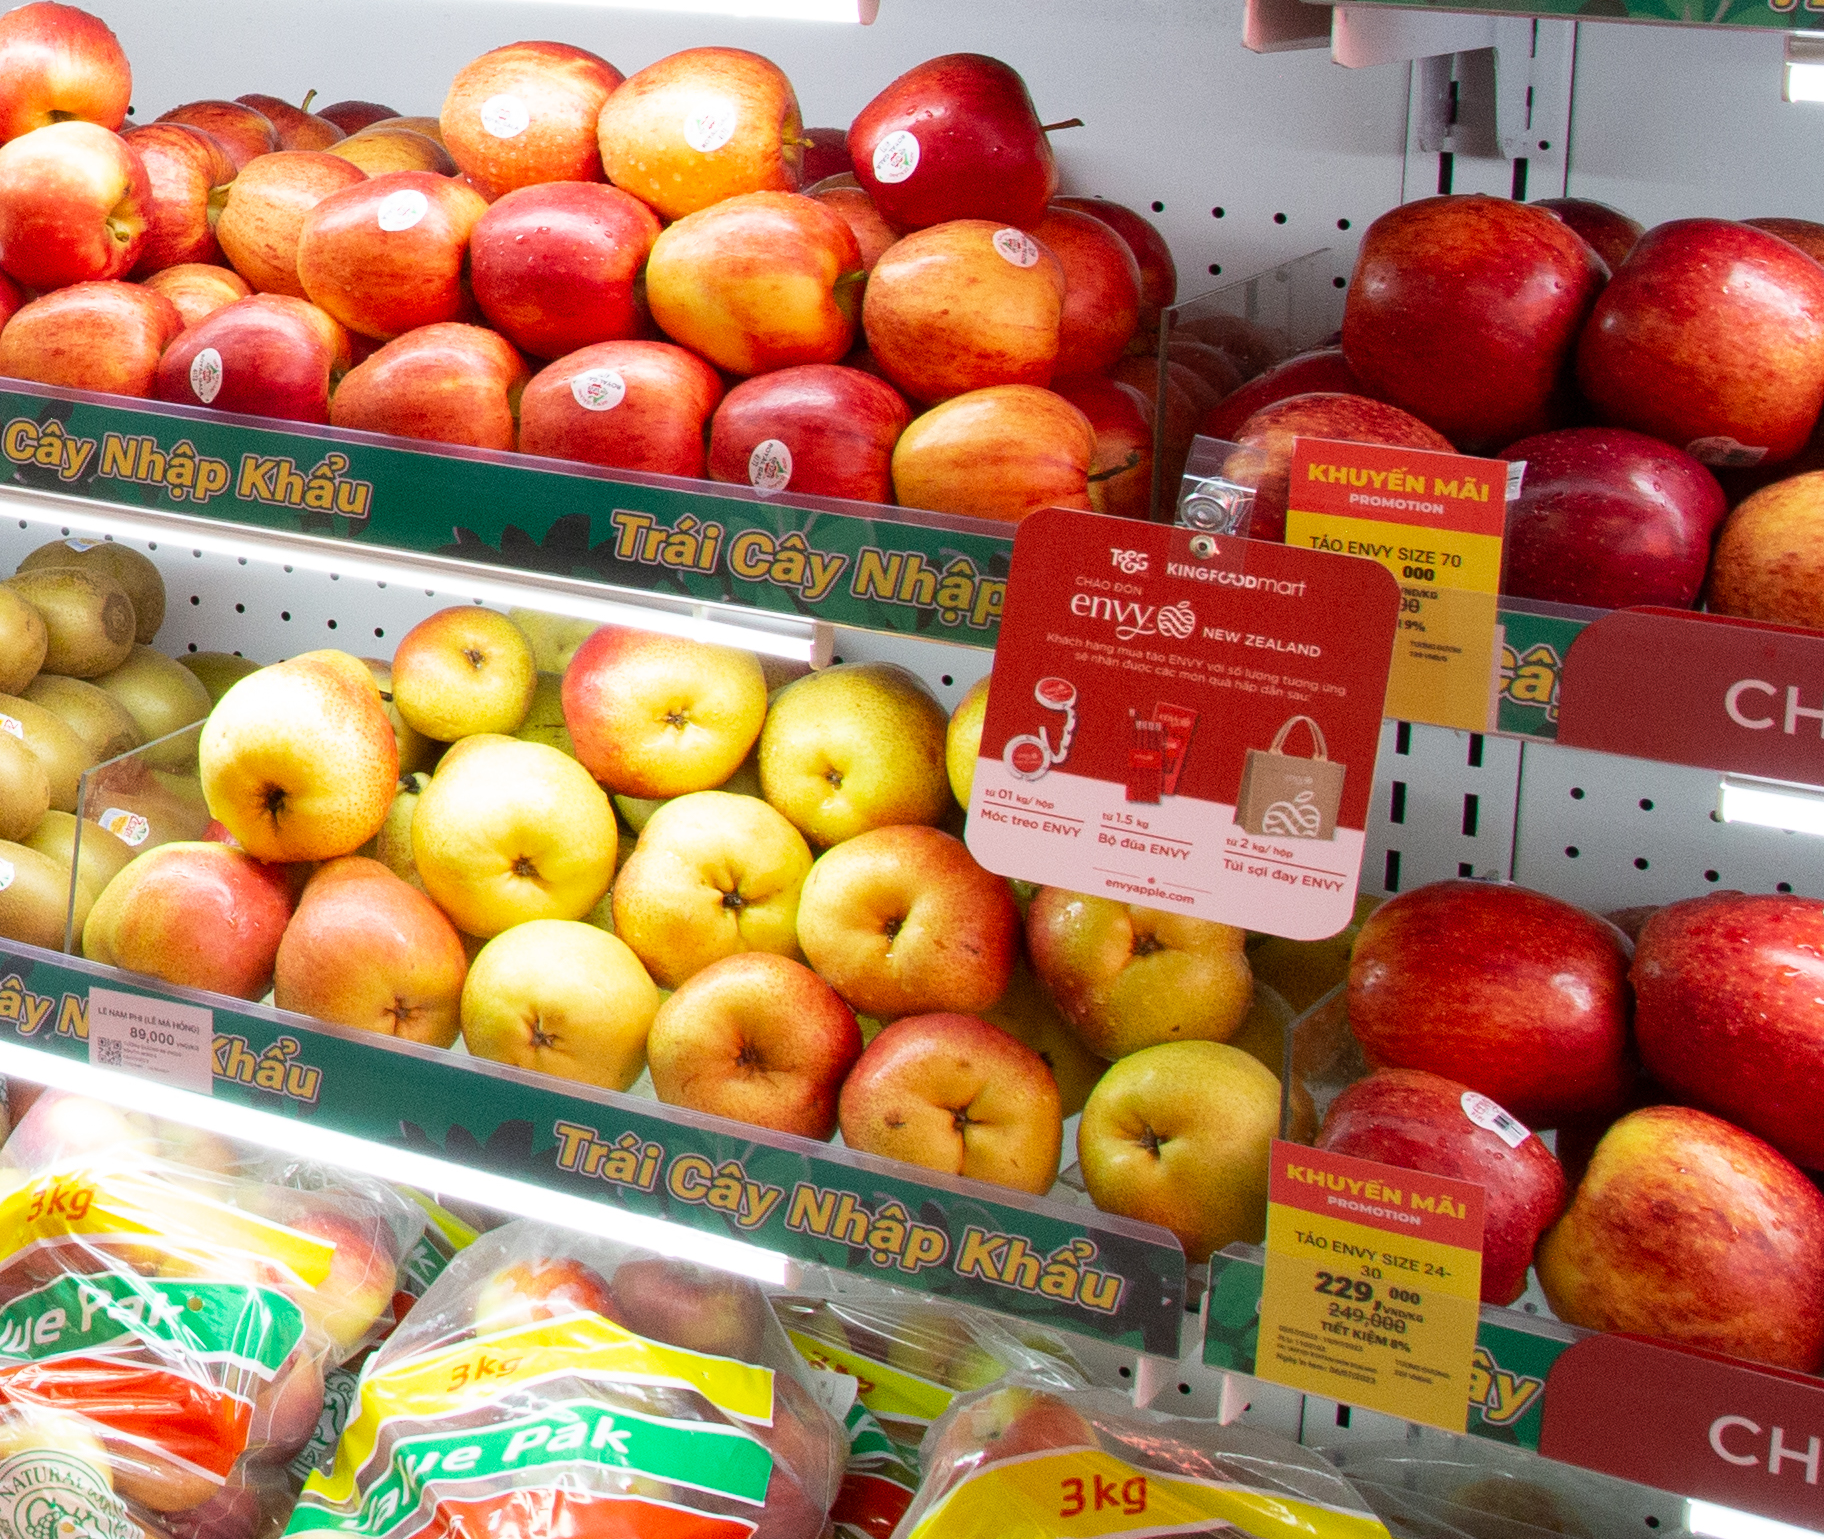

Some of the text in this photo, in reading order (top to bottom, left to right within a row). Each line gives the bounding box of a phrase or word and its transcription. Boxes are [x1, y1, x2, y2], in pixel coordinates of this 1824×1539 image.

[1307, 461, 1490, 503] KHUYẾN MÃI
[1349, 492, 1444, 515] PROMOTION
[1110, 547, 1308, 598] T&G KINGFOODmart
[1070, 591, 1322, 659] envy NEW ZEALAND
[1149, 842, 1191, 862] ENVY
[1105, 877, 1195, 905] envyapple.com
[1223, 857, 1246, 874] Túi
[1302, 872, 1344, 894] ENVY
[25, 1184, 95, 1223] 3kg
[1286, 1163, 1466, 1220] KHUYẾN MÃI
[1327, 1195, 1421, 1225] PROMOTION
[1058, 1476, 1149, 1519] 3kg
